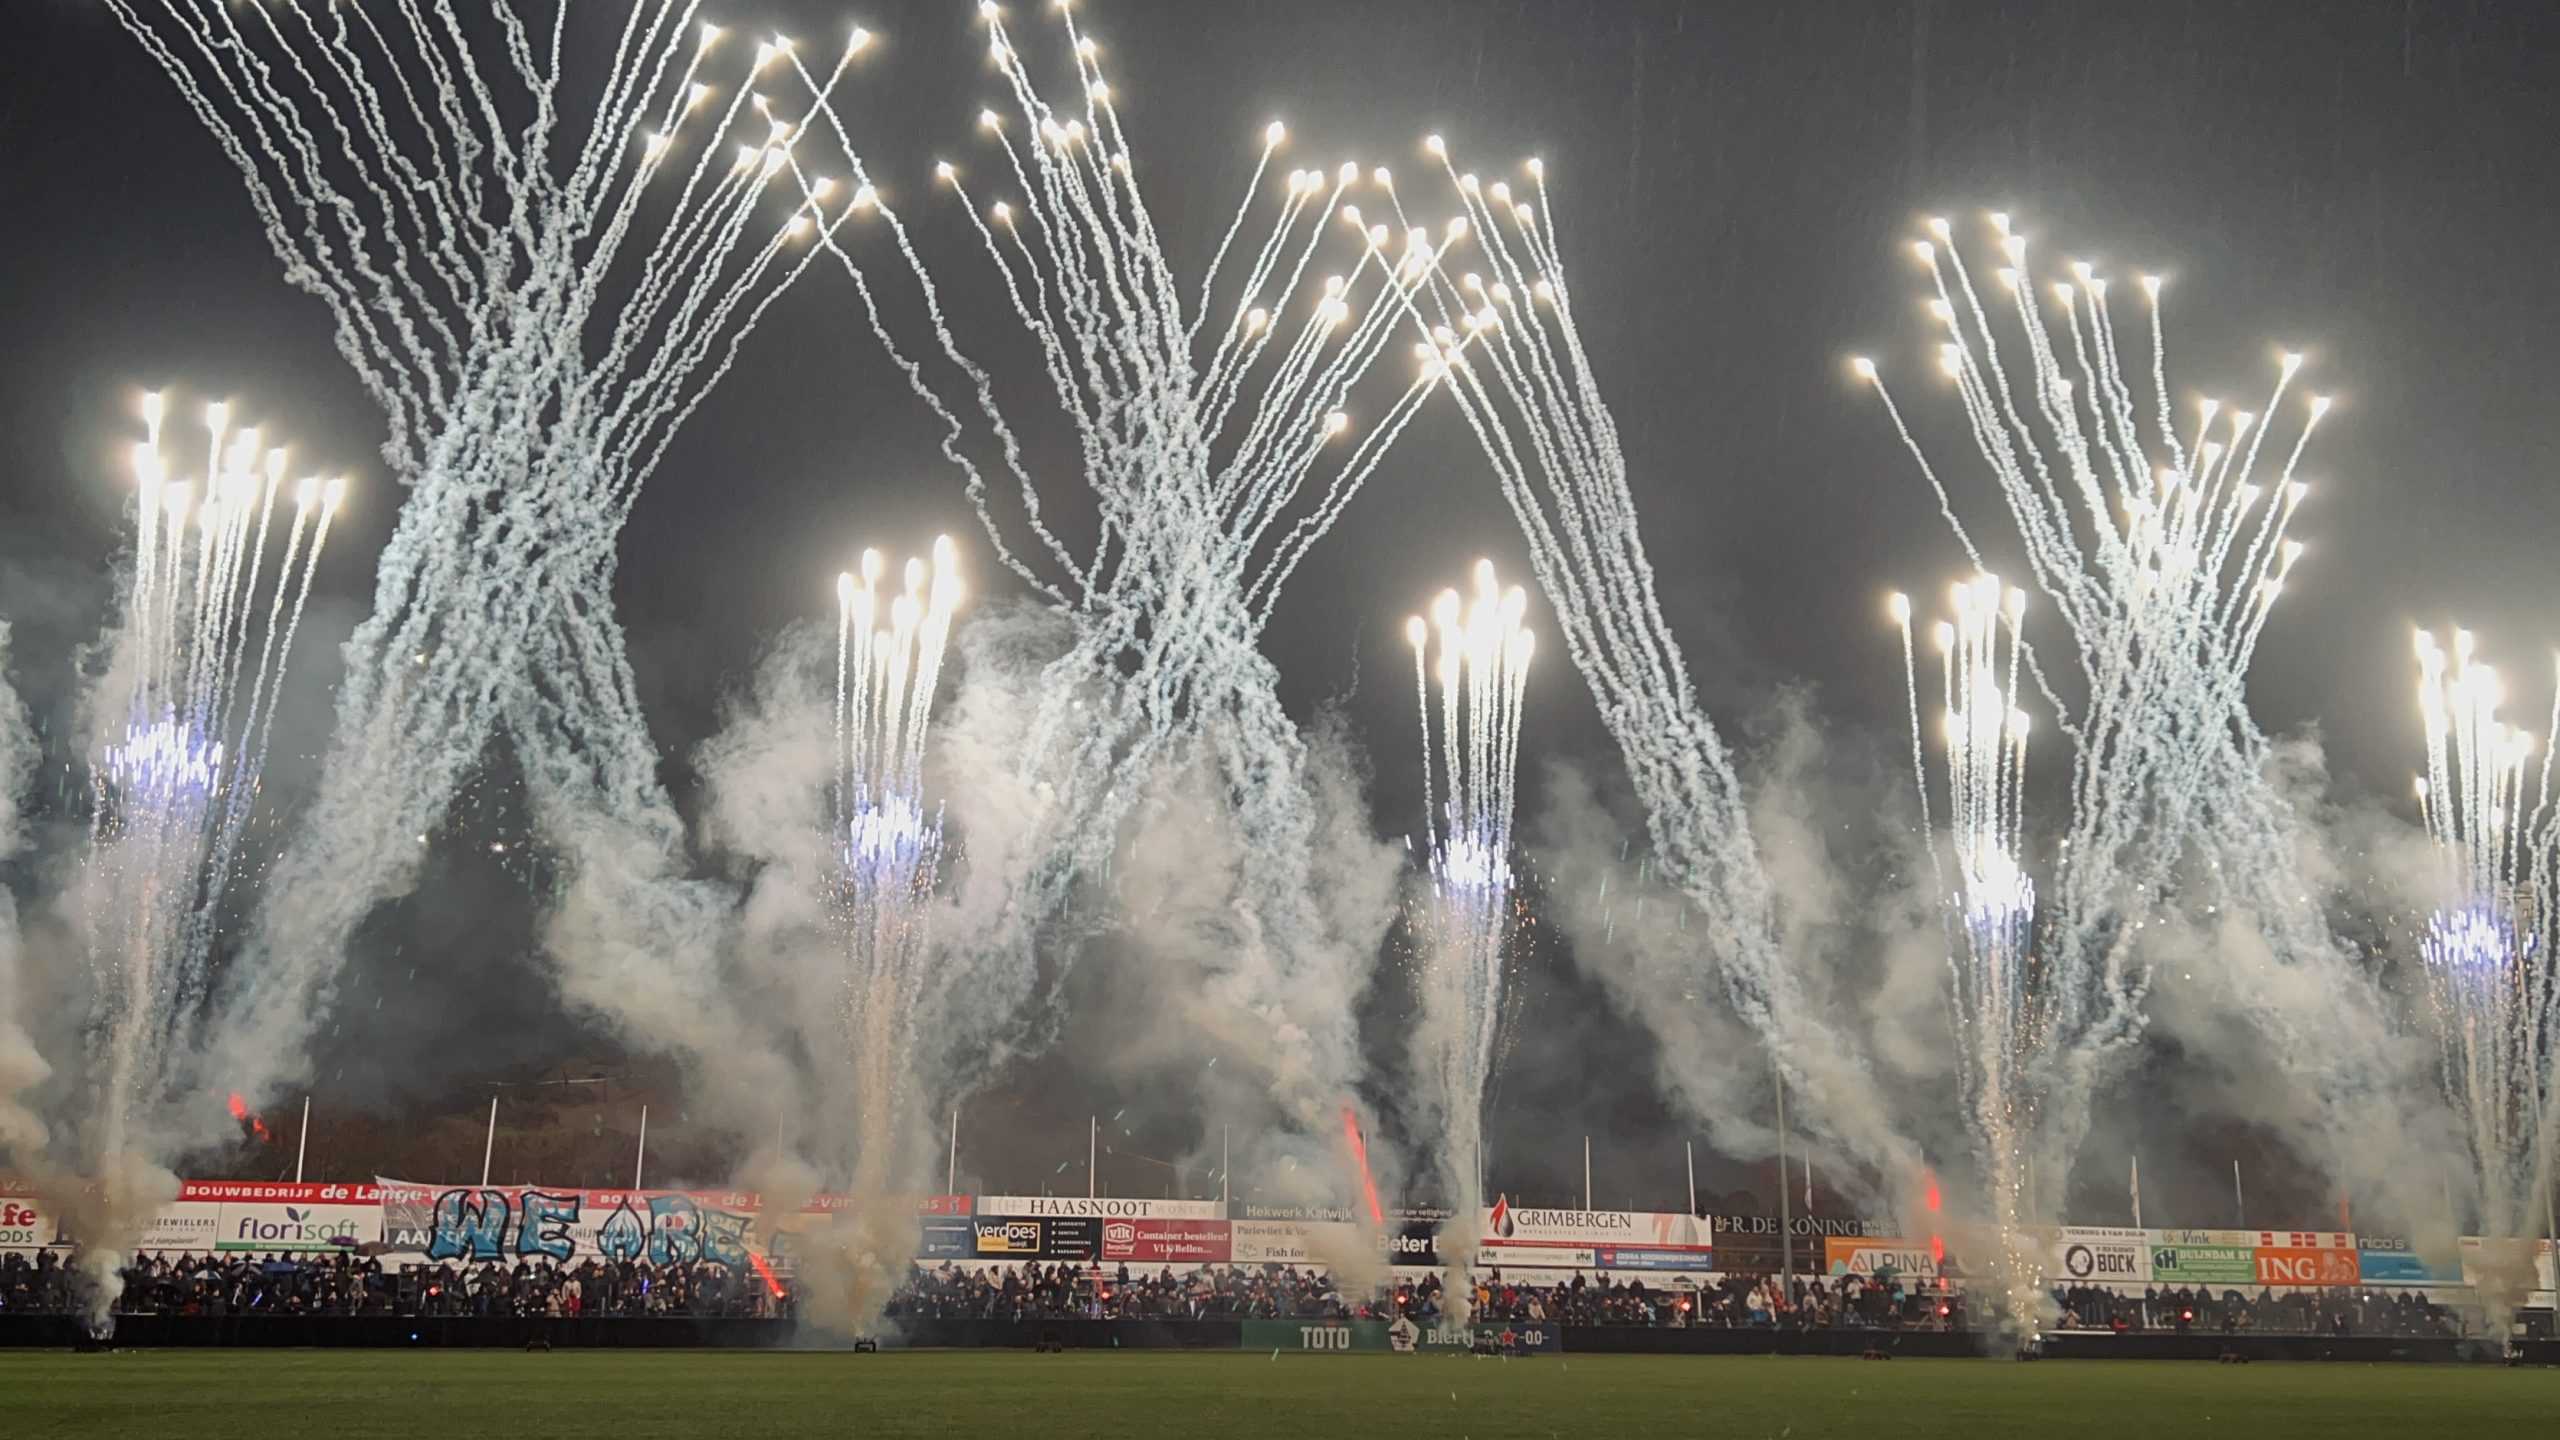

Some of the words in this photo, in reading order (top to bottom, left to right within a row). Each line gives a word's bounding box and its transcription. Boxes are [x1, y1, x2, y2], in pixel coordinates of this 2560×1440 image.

[186, 1185, 314, 1199] BOUWBEDRIJF
[320, 1184, 349, 1200] de
[1030, 1199, 1152, 1217] HAASNOOT
[1246, 1205, 1302, 1218] Hekwerk
[238, 1217, 359, 1241] florisoft
[1517, 1210, 1632, 1229] GRIMBERGEN
[1753, 1217, 1777, 1233] DE
[1789, 1218, 1858, 1236] KONING
[2182, 1230, 2209, 1244] Vink
[1265, 1247, 1288, 1258] Fish
[1290, 1247, 1305, 1258] for
[1851, 1253, 1934, 1273] ALPINA
[2097, 1254, 2136, 1273] BOCK
[2259, 1256, 2316, 1281] ING
[1301, 1326, 1351, 1349] TOTO
